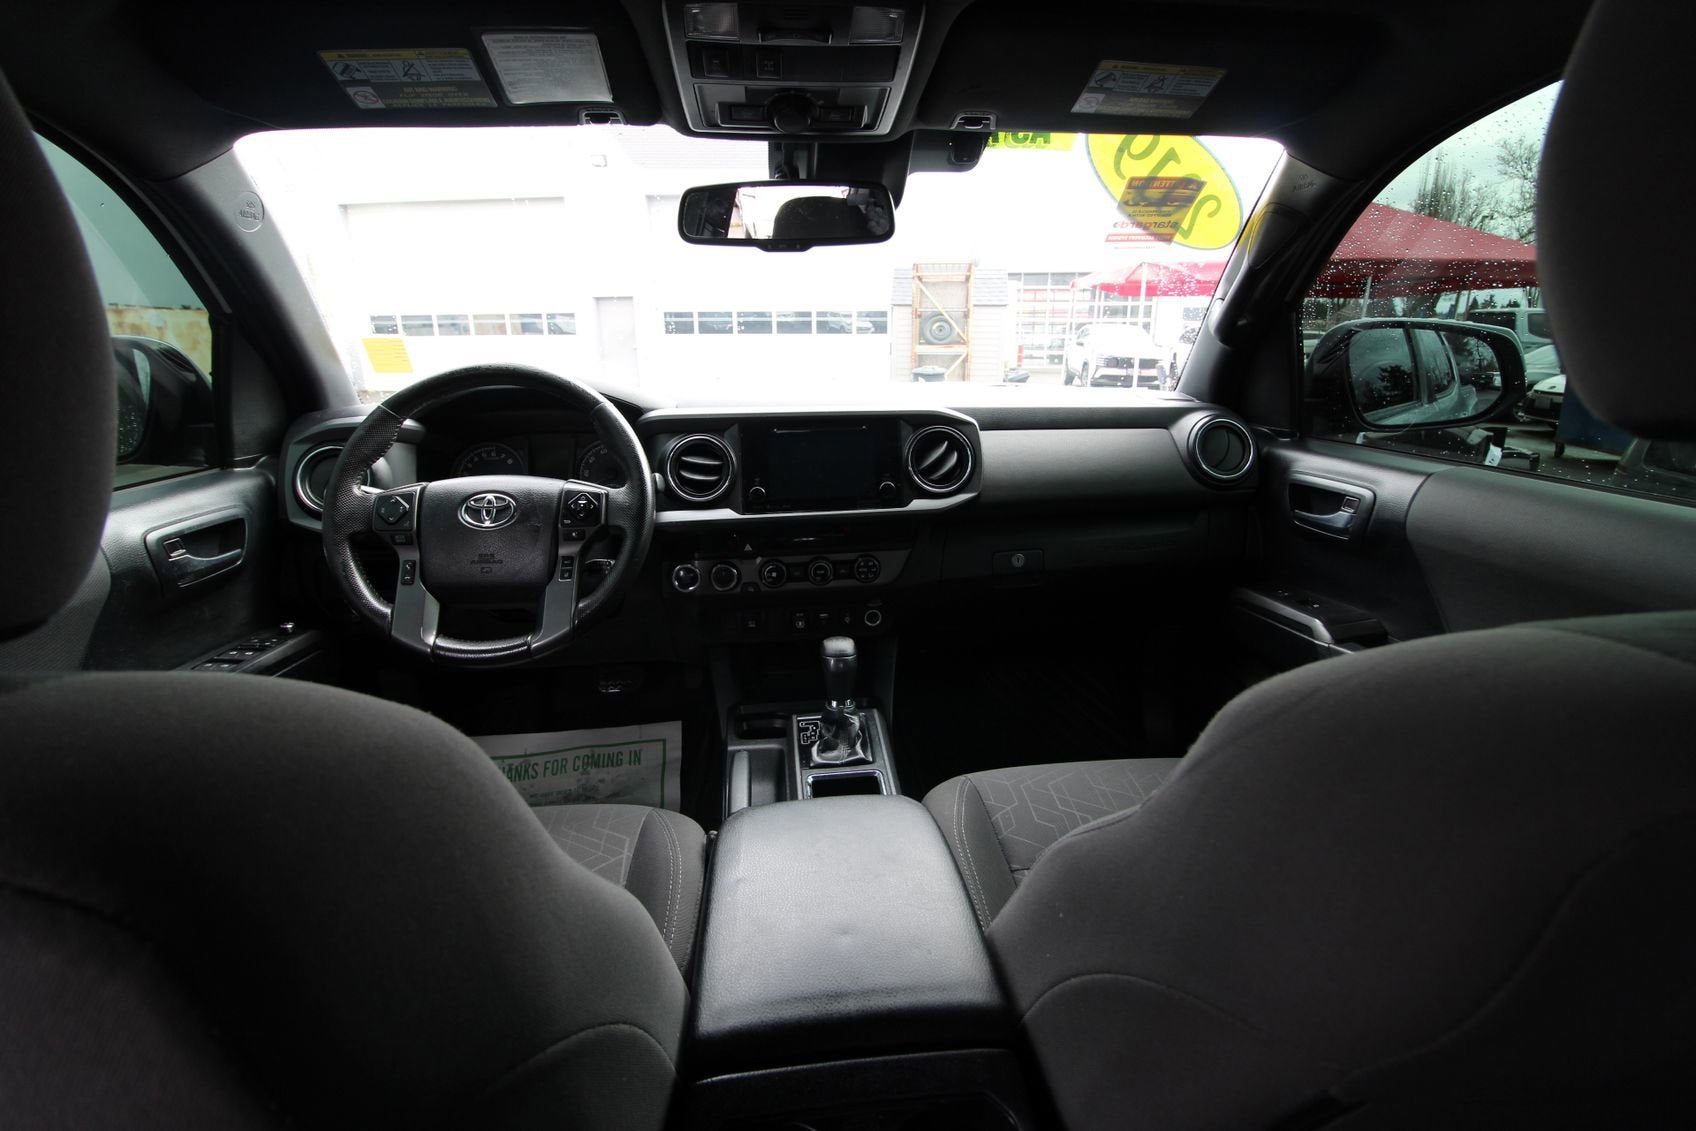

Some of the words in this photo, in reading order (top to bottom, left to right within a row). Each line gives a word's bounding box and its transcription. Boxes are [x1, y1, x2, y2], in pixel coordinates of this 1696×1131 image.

[502, 762, 538, 783] ANKS
[543, 757, 568, 778] FOR
[572, 751, 624, 772] COMING
[628, 749, 642, 766] IN
